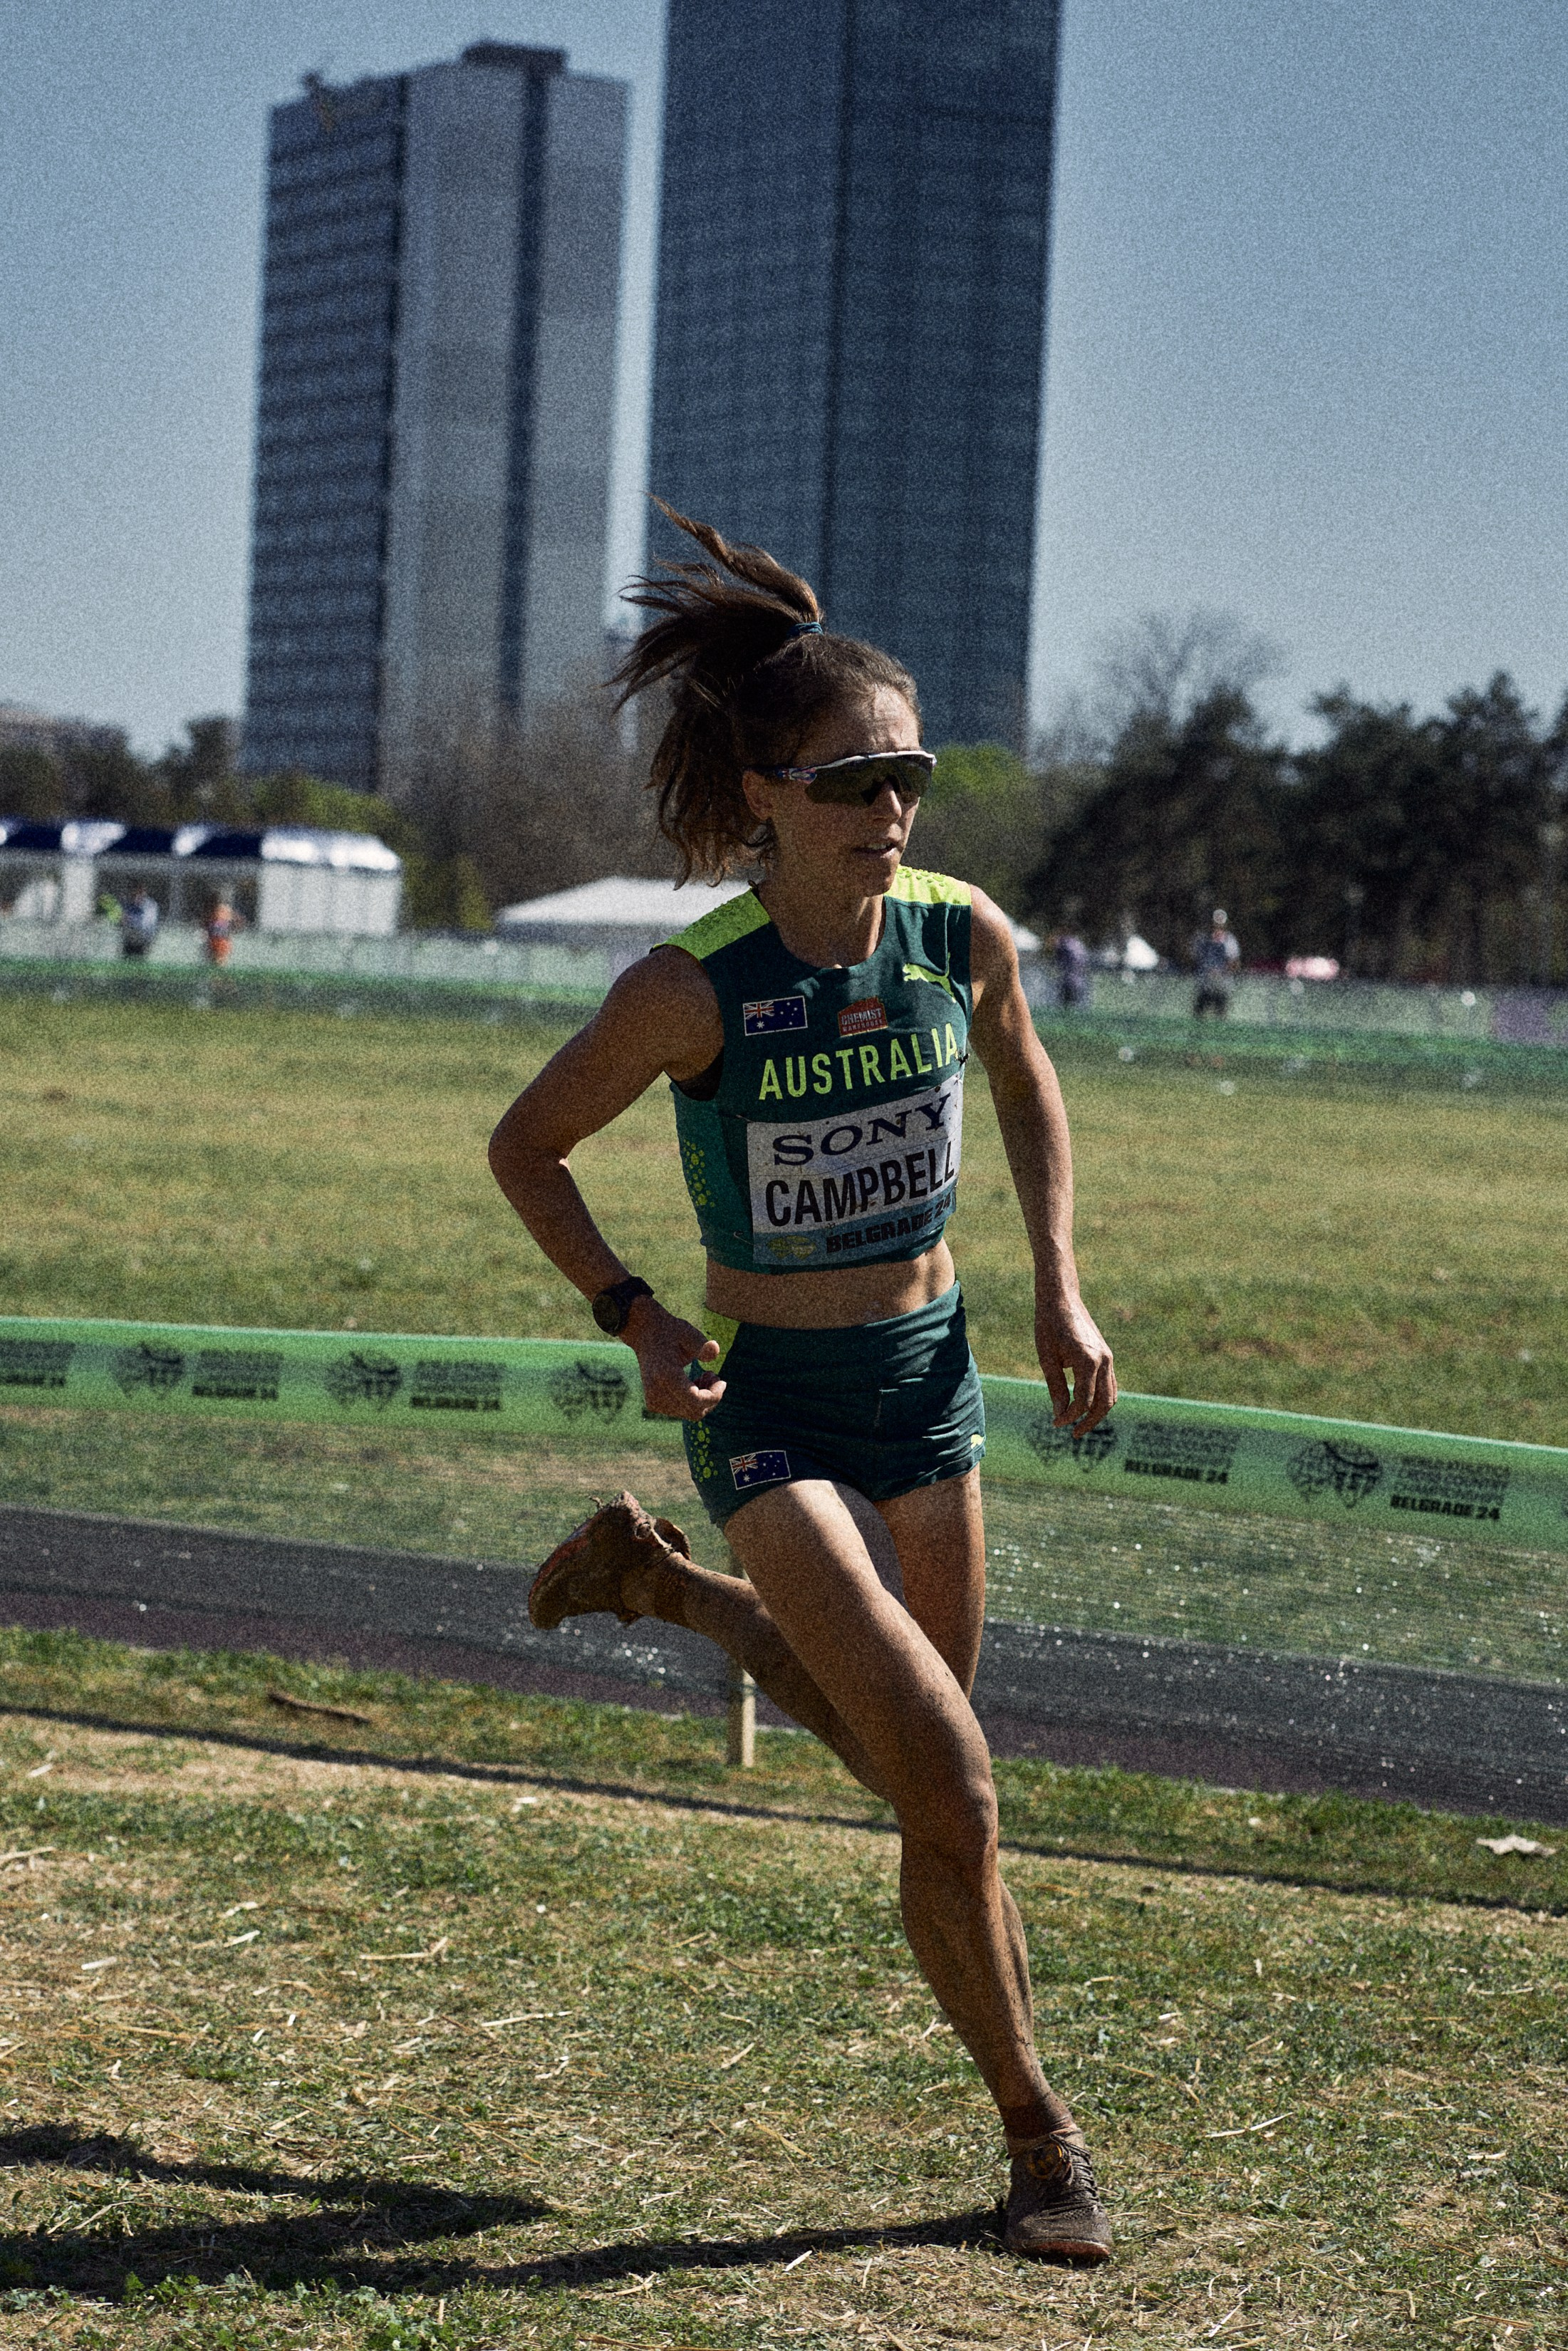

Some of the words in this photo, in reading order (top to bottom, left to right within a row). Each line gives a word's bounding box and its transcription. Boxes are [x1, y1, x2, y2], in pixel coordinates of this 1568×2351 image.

[841, 1008, 882, 1025] CHEMIST
[843, 1019, 883, 1032] WAREHOUSE
[759, 1023, 958, 1100] AUSTRALIA
[773, 1093, 951, 1166] SONY
[765, 1141, 955, 1226] CAMPBELL
[826, 1208, 933, 1253] BELGRADE
[1391, 1494, 1473, 1517] BELGRADE
